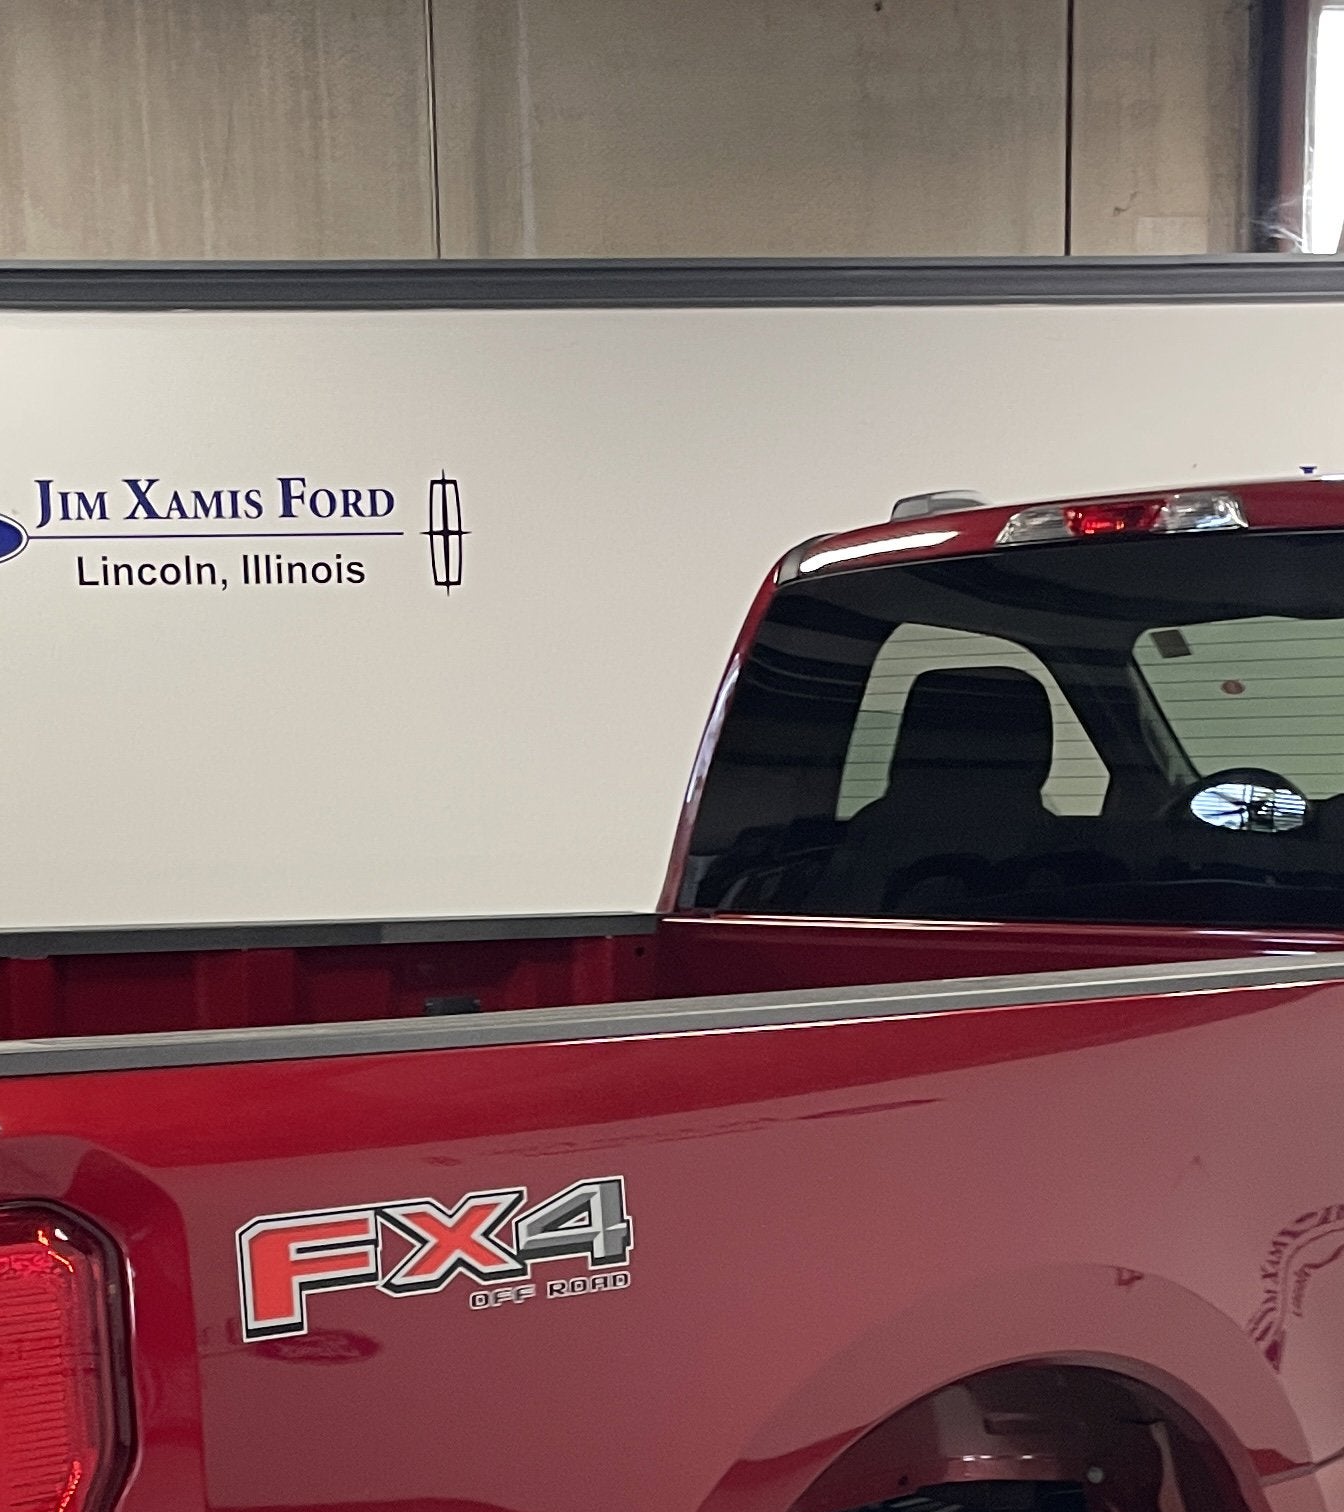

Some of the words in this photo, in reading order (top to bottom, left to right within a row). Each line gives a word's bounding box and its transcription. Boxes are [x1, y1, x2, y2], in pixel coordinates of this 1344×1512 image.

[33, 478, 109, 529] JIM
[123, 477, 263, 521] XAMIS
[276, 476, 395, 520] FORD
[77, 555, 229, 591] Lincoln,
[242, 553, 366, 586] Illinois
[235, 1175, 635, 1343] FX4
[468, 1285, 538, 1311] OFF
[545, 1271, 632, 1300] ROAD
